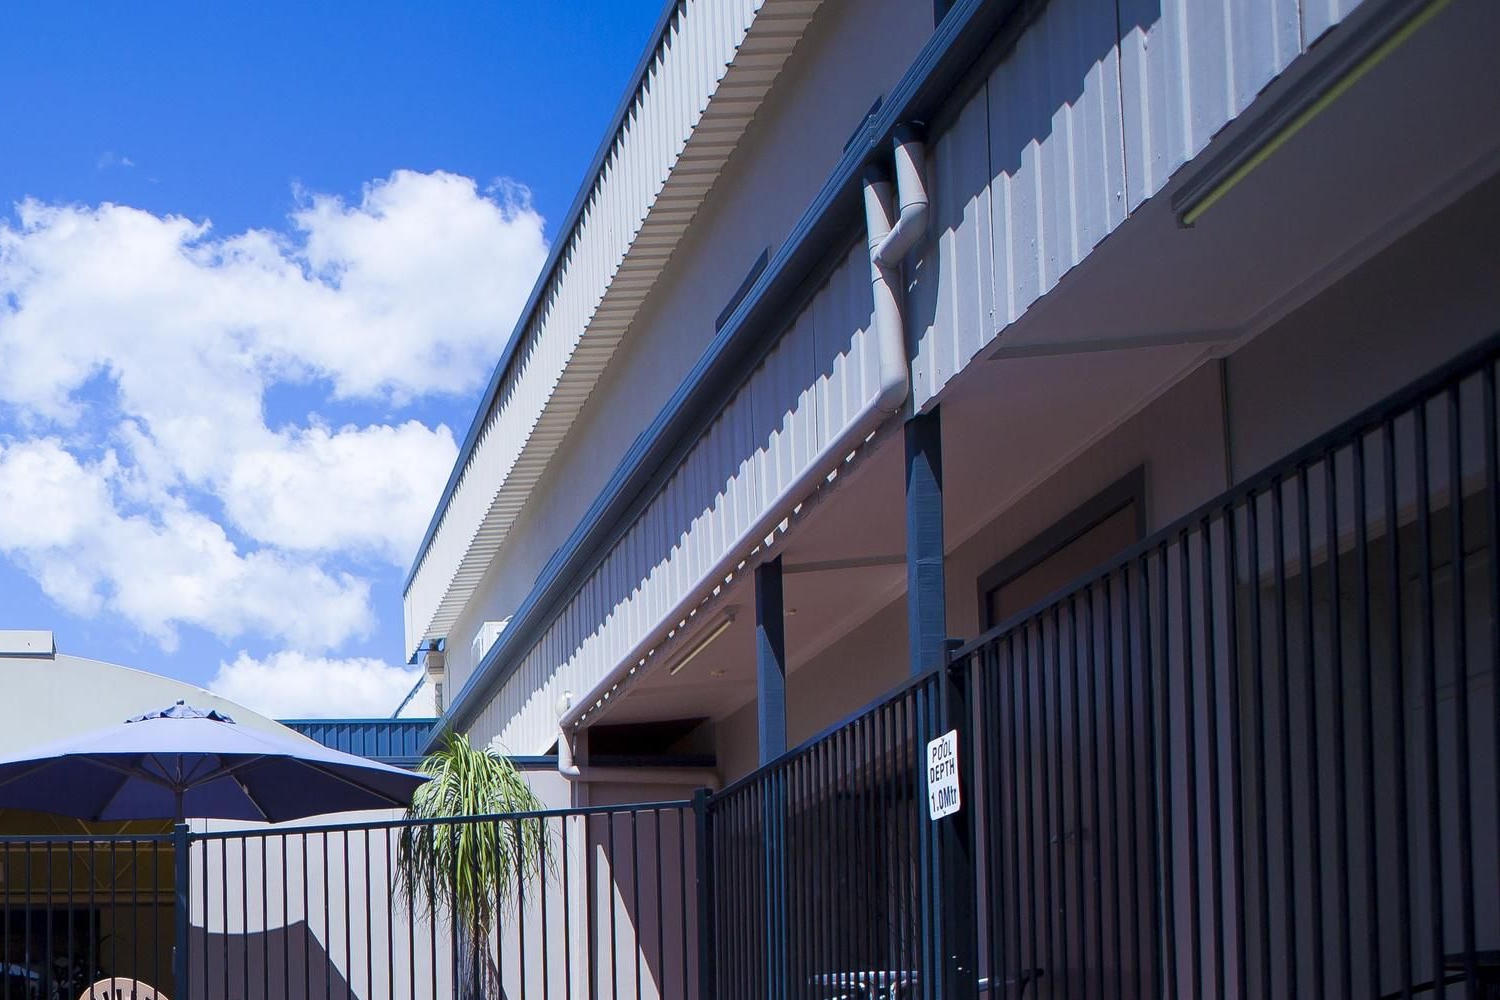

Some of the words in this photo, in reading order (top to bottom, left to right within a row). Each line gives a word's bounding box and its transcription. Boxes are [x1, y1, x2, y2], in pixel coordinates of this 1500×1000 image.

[932, 740, 952, 763] POOL
[930, 758, 955, 784] DEPTH
[931, 785, 957, 812] 1.0Mtr
